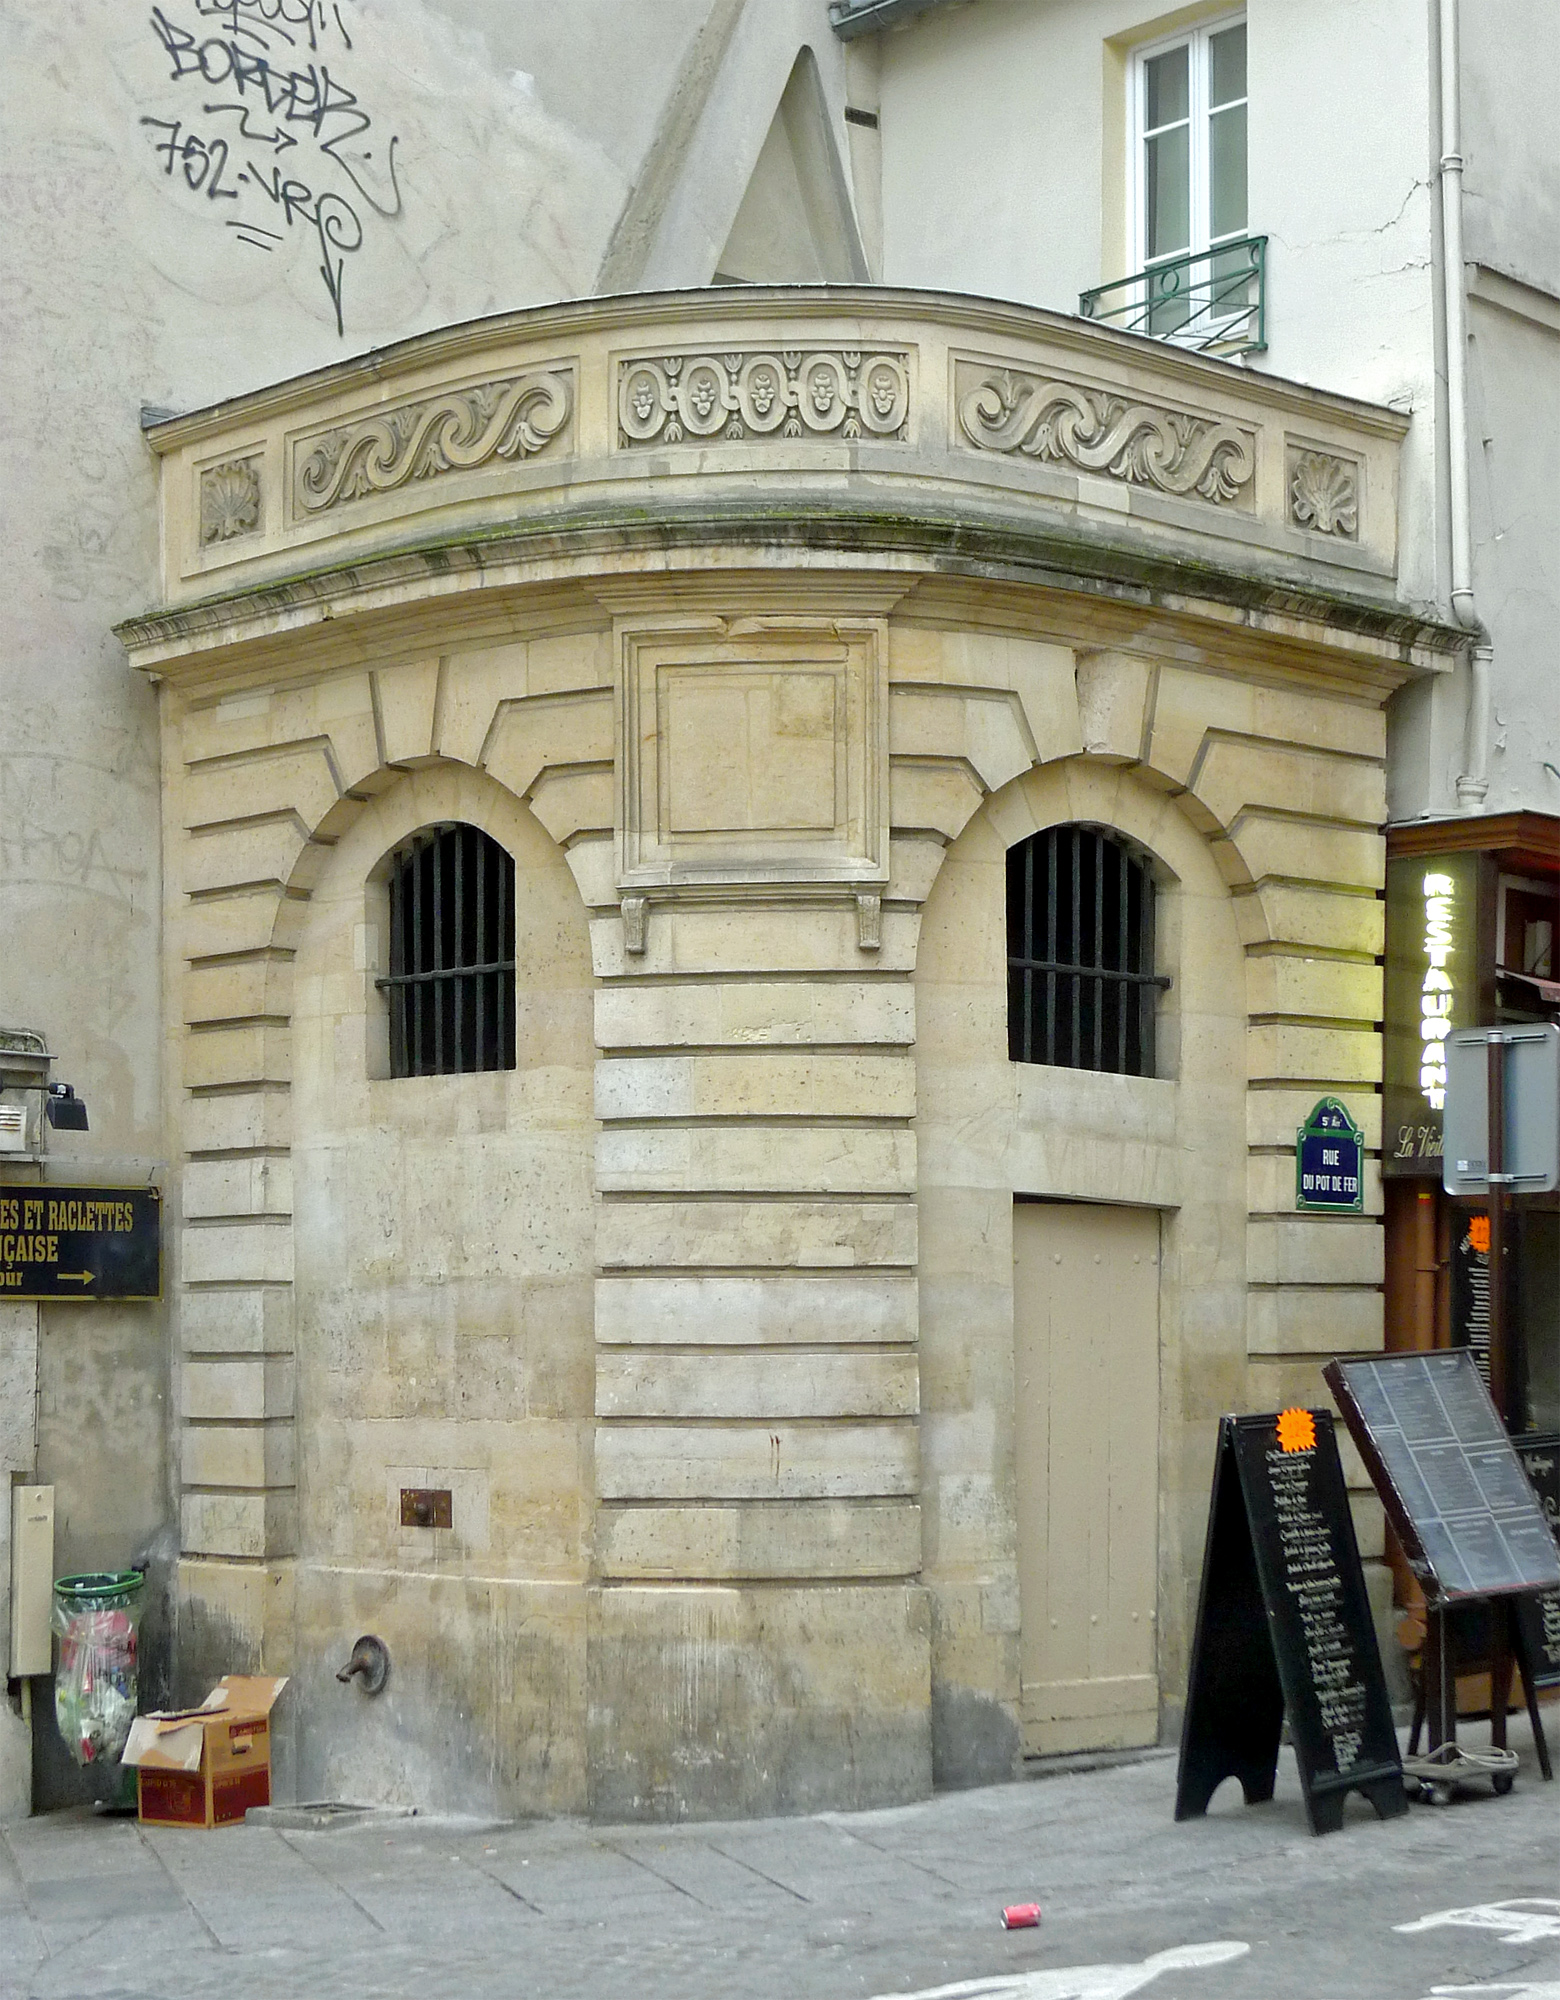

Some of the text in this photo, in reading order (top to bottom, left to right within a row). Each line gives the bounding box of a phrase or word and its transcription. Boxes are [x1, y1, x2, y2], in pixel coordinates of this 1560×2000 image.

[1322, 1149, 1340, 1166] RUE
[1393, 1125, 1414, 1158] La
[1302, 1173, 1358, 1193] DU POT DE FER
[24, 1199, 43, 1230] ET
[48, 1200, 133, 1231] RACLETTES
[0, 1235, 58, 1269] ÇAISE
